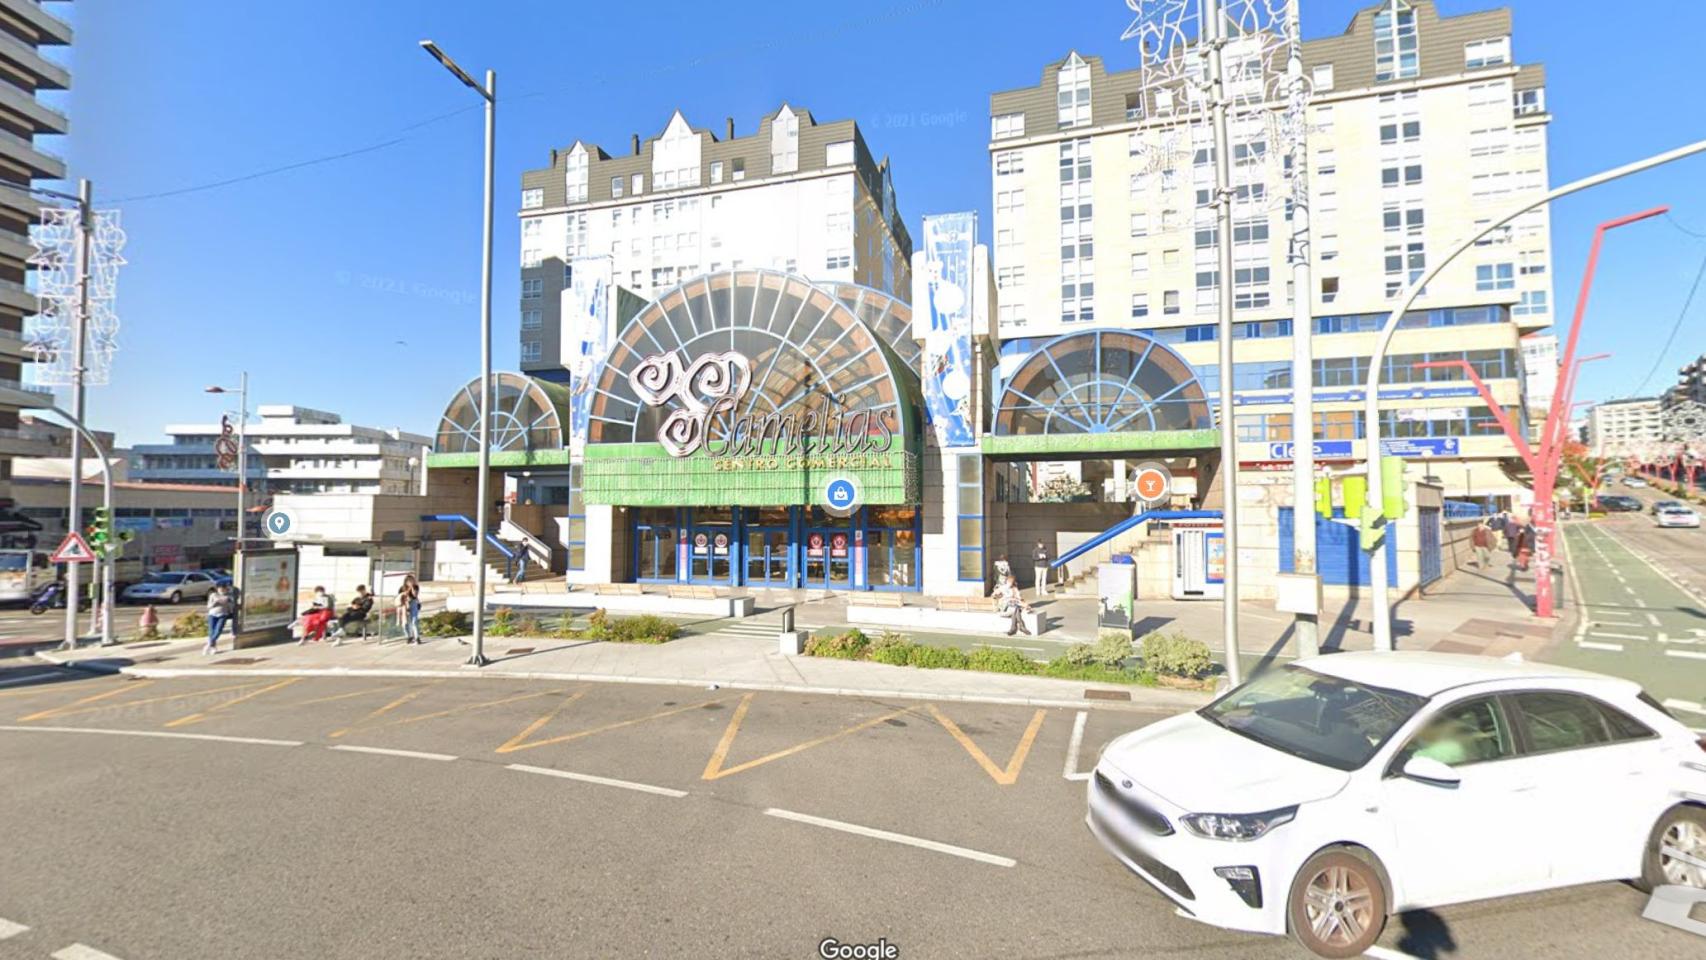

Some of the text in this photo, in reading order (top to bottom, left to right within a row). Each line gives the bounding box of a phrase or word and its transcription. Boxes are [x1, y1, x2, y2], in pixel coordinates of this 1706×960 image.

[702, 394, 894, 457] Camelias
[714, 456, 893, 471] CENTRO COMERCIAL
